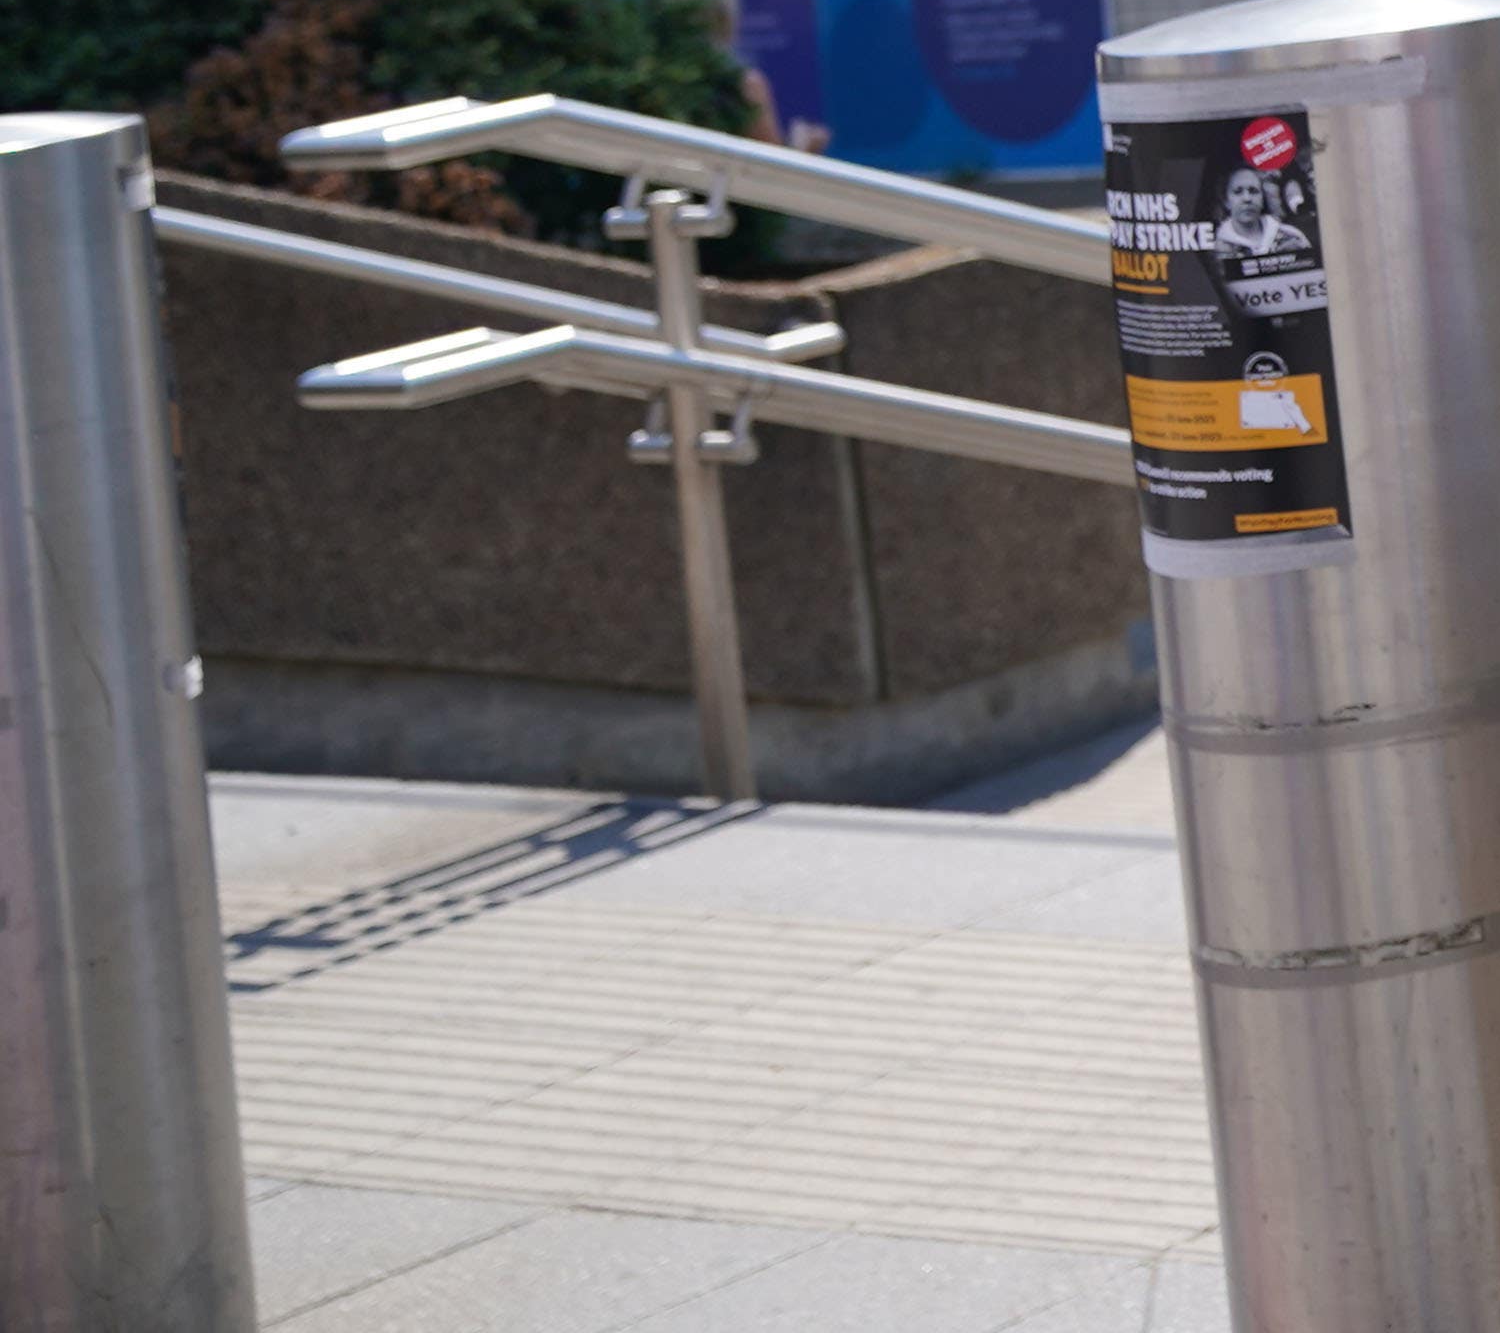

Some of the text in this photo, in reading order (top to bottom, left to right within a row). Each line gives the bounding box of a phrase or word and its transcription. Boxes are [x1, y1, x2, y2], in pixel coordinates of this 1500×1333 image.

[1133, 193, 1180, 221] NHS
[1135, 222, 1215, 251] STRIKE
[1235, 282, 1328, 308] Vote YES
[1234, 468, 1274, 483] voting
